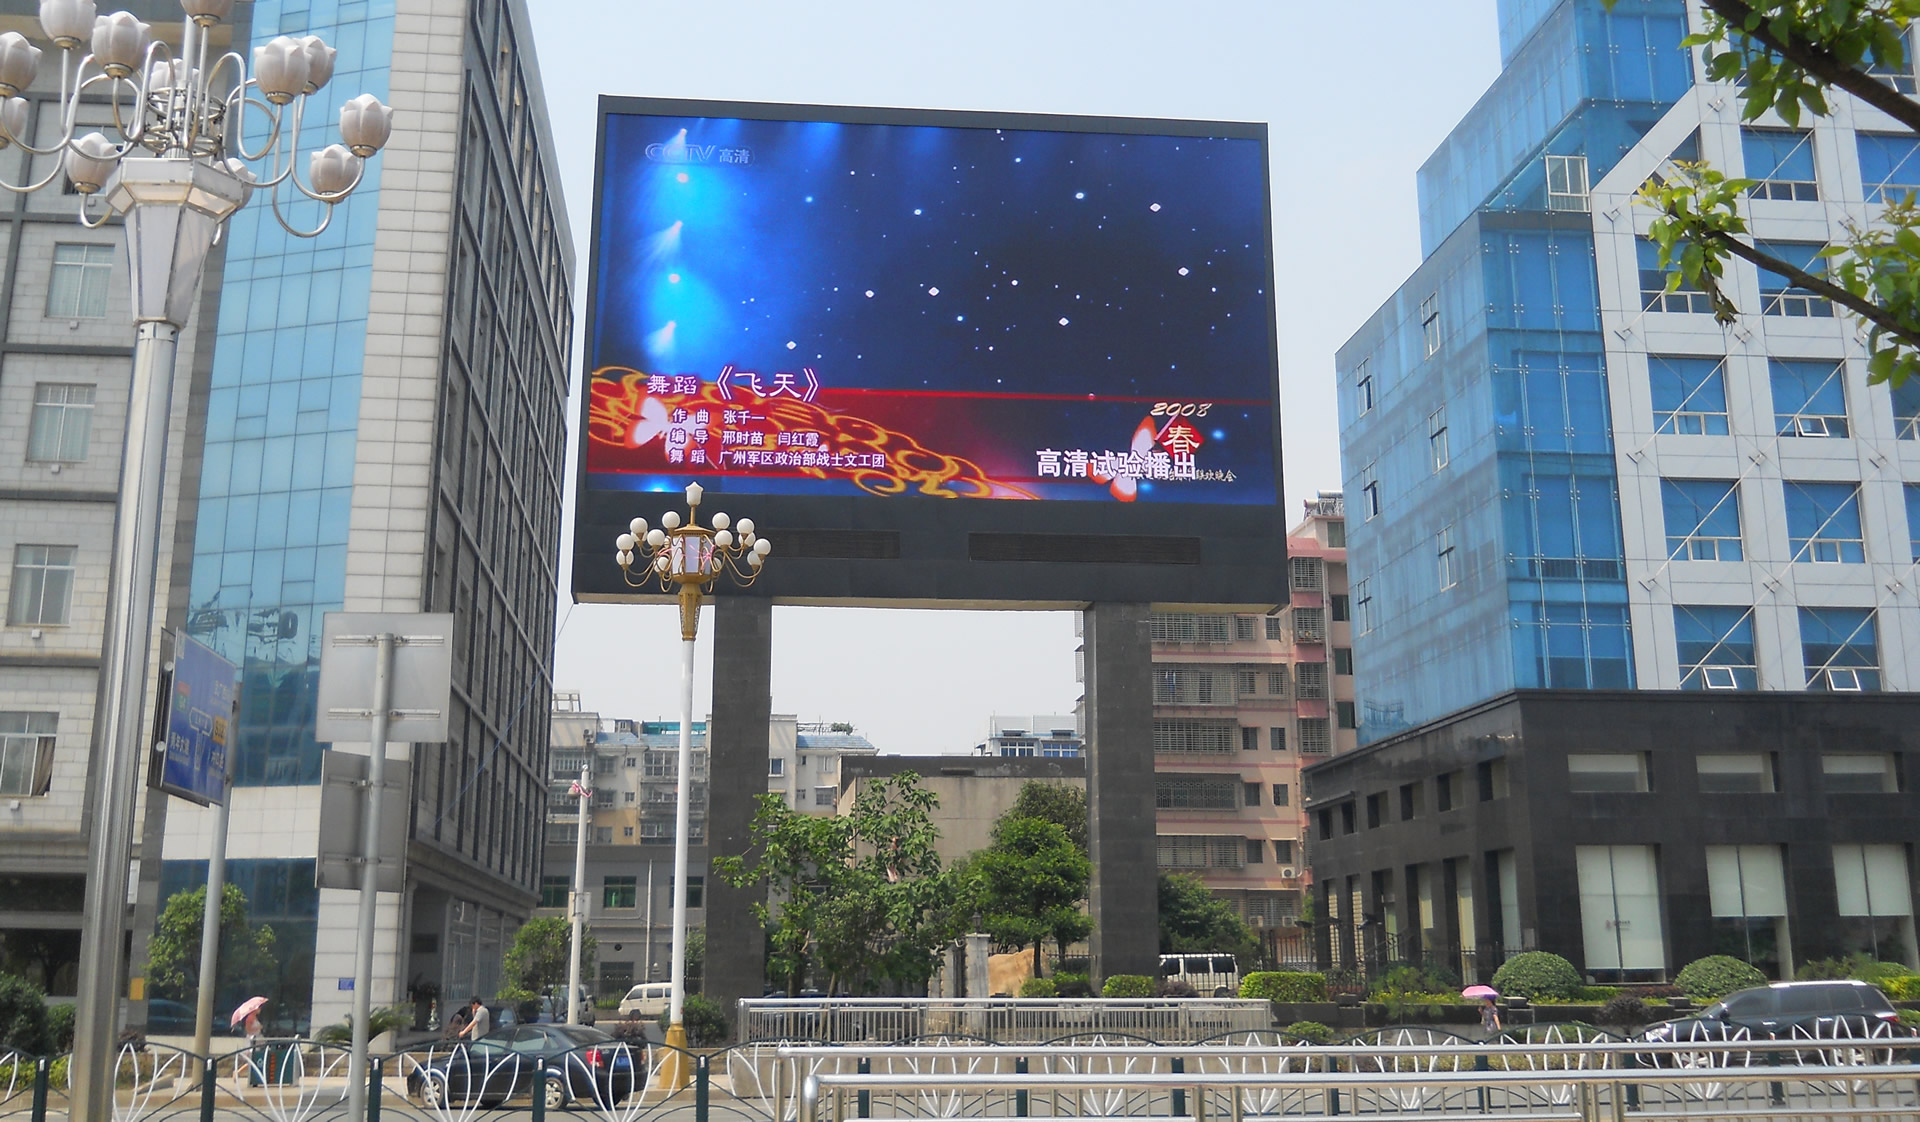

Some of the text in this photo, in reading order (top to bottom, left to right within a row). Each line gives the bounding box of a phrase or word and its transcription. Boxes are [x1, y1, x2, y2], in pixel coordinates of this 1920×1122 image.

[645, 143, 716, 162] CCTV
[719, 148, 750, 164] 高清
[647, 366, 819, 402] 舞蹈 《飞天》
[672, 409, 765, 424] 作曲 张千一
[1150, 402, 1212, 417] 2008
[671, 429, 820, 448] 编导 邢时苗 闫红霞
[1162, 425, 1200, 453] 春
[669, 449, 885, 468] 舞蹈 广州军区政治部战士文工团
[1036, 449, 1196, 478] 高清试验播出
